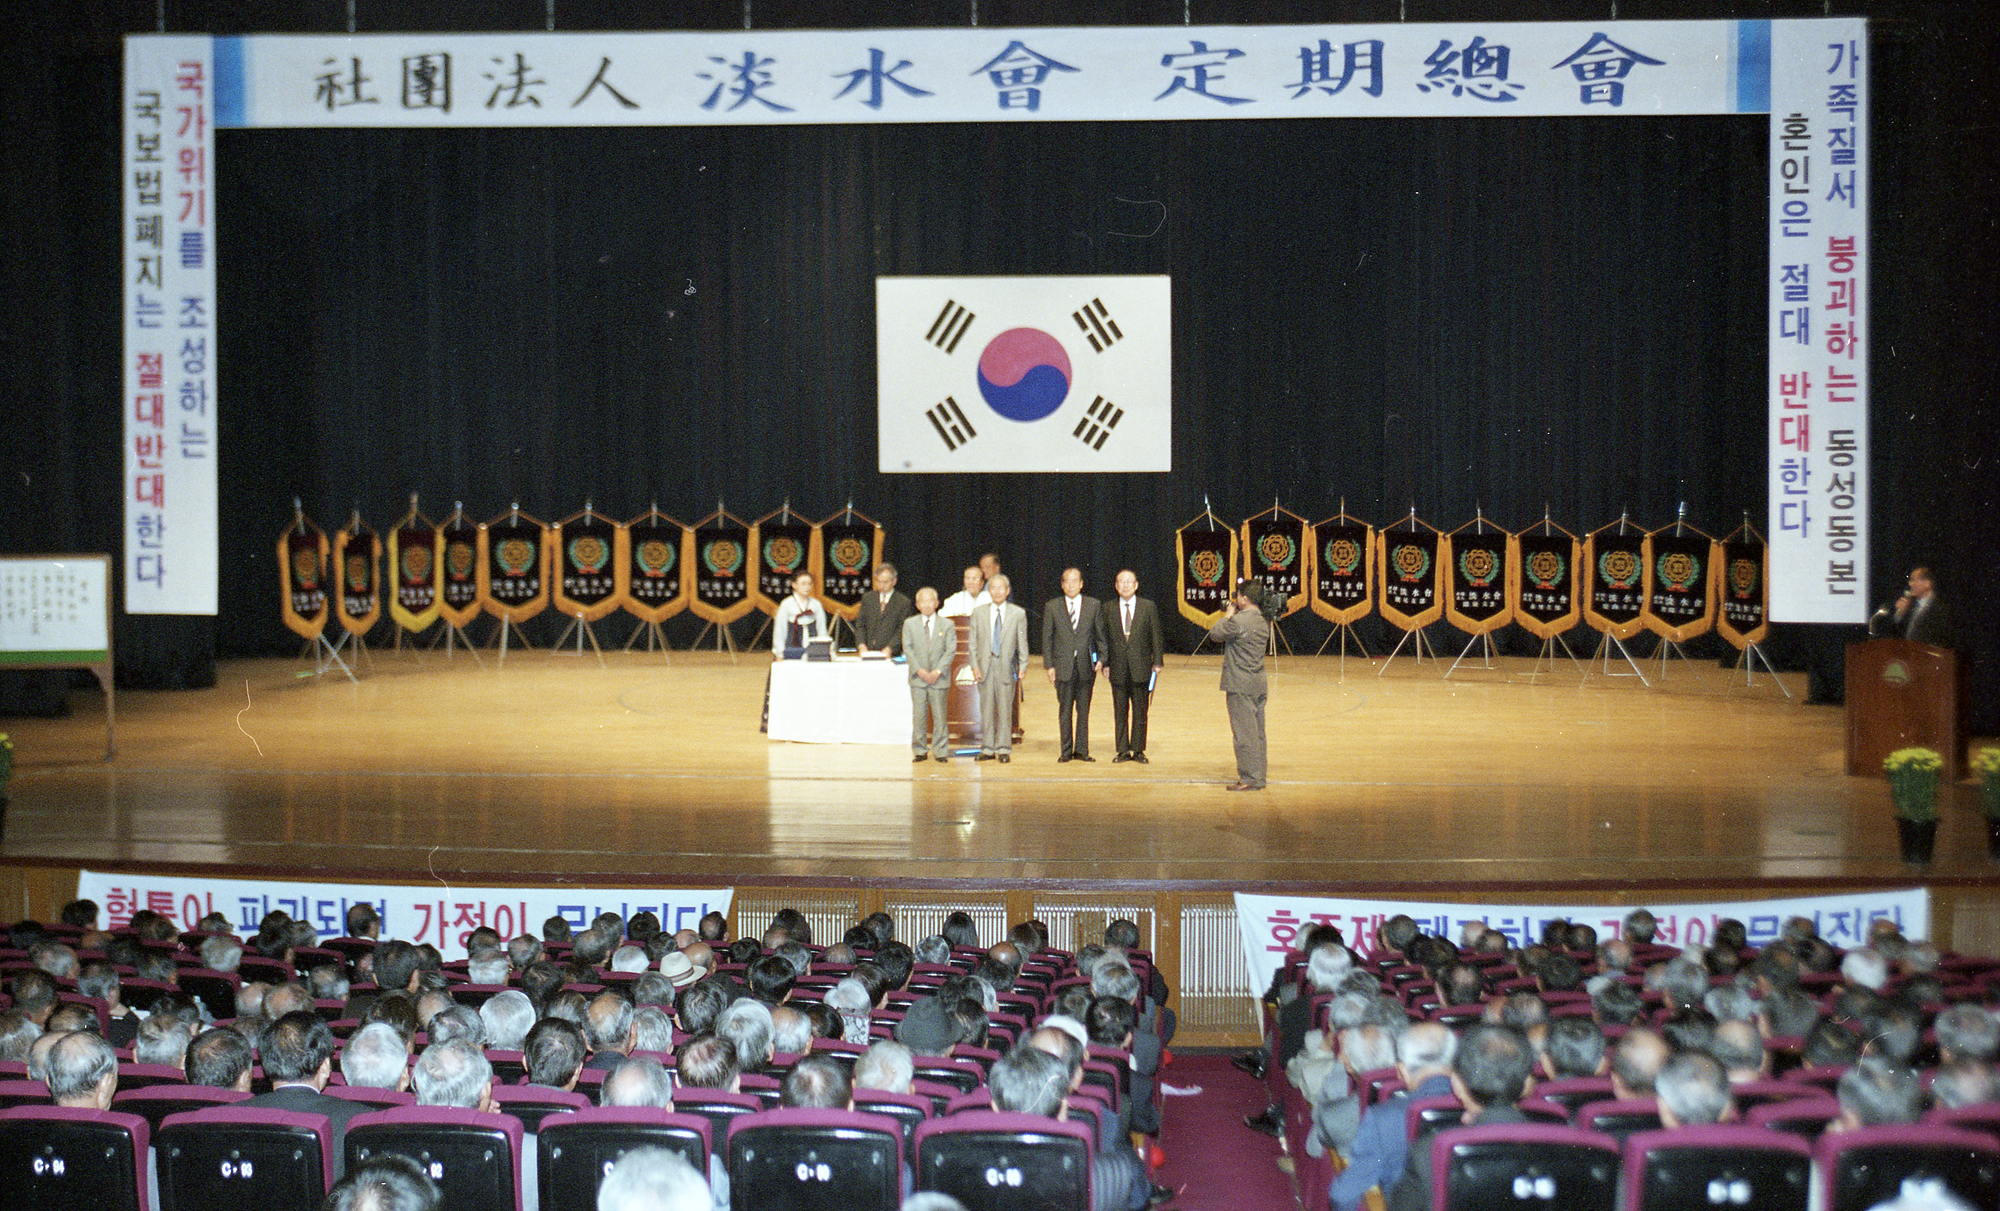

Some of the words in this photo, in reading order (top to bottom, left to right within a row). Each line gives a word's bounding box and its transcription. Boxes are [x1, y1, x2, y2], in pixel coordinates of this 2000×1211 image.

[315, 52, 641, 113] 社團法人
[696, 40, 1082, 112] 淡水會
[1153, 31, 1667, 107] 定期總會
[1825, 39, 1859, 209] 가족질서
[134, 90, 164, 329] 국보법폐지는
[175, 62, 206, 269] 국가위기를
[1778, 112, 1812, 238] 혼인은
[179, 296, 208, 460] 조성하는
[1779, 262, 1810, 346] 절대
[1824, 235, 1858, 403] 붕괴하는
[1778, 370, 1812, 539] 반대한다
[1824, 428, 1858, 596] 동성동본
[414, 900, 527, 956] 가정이
